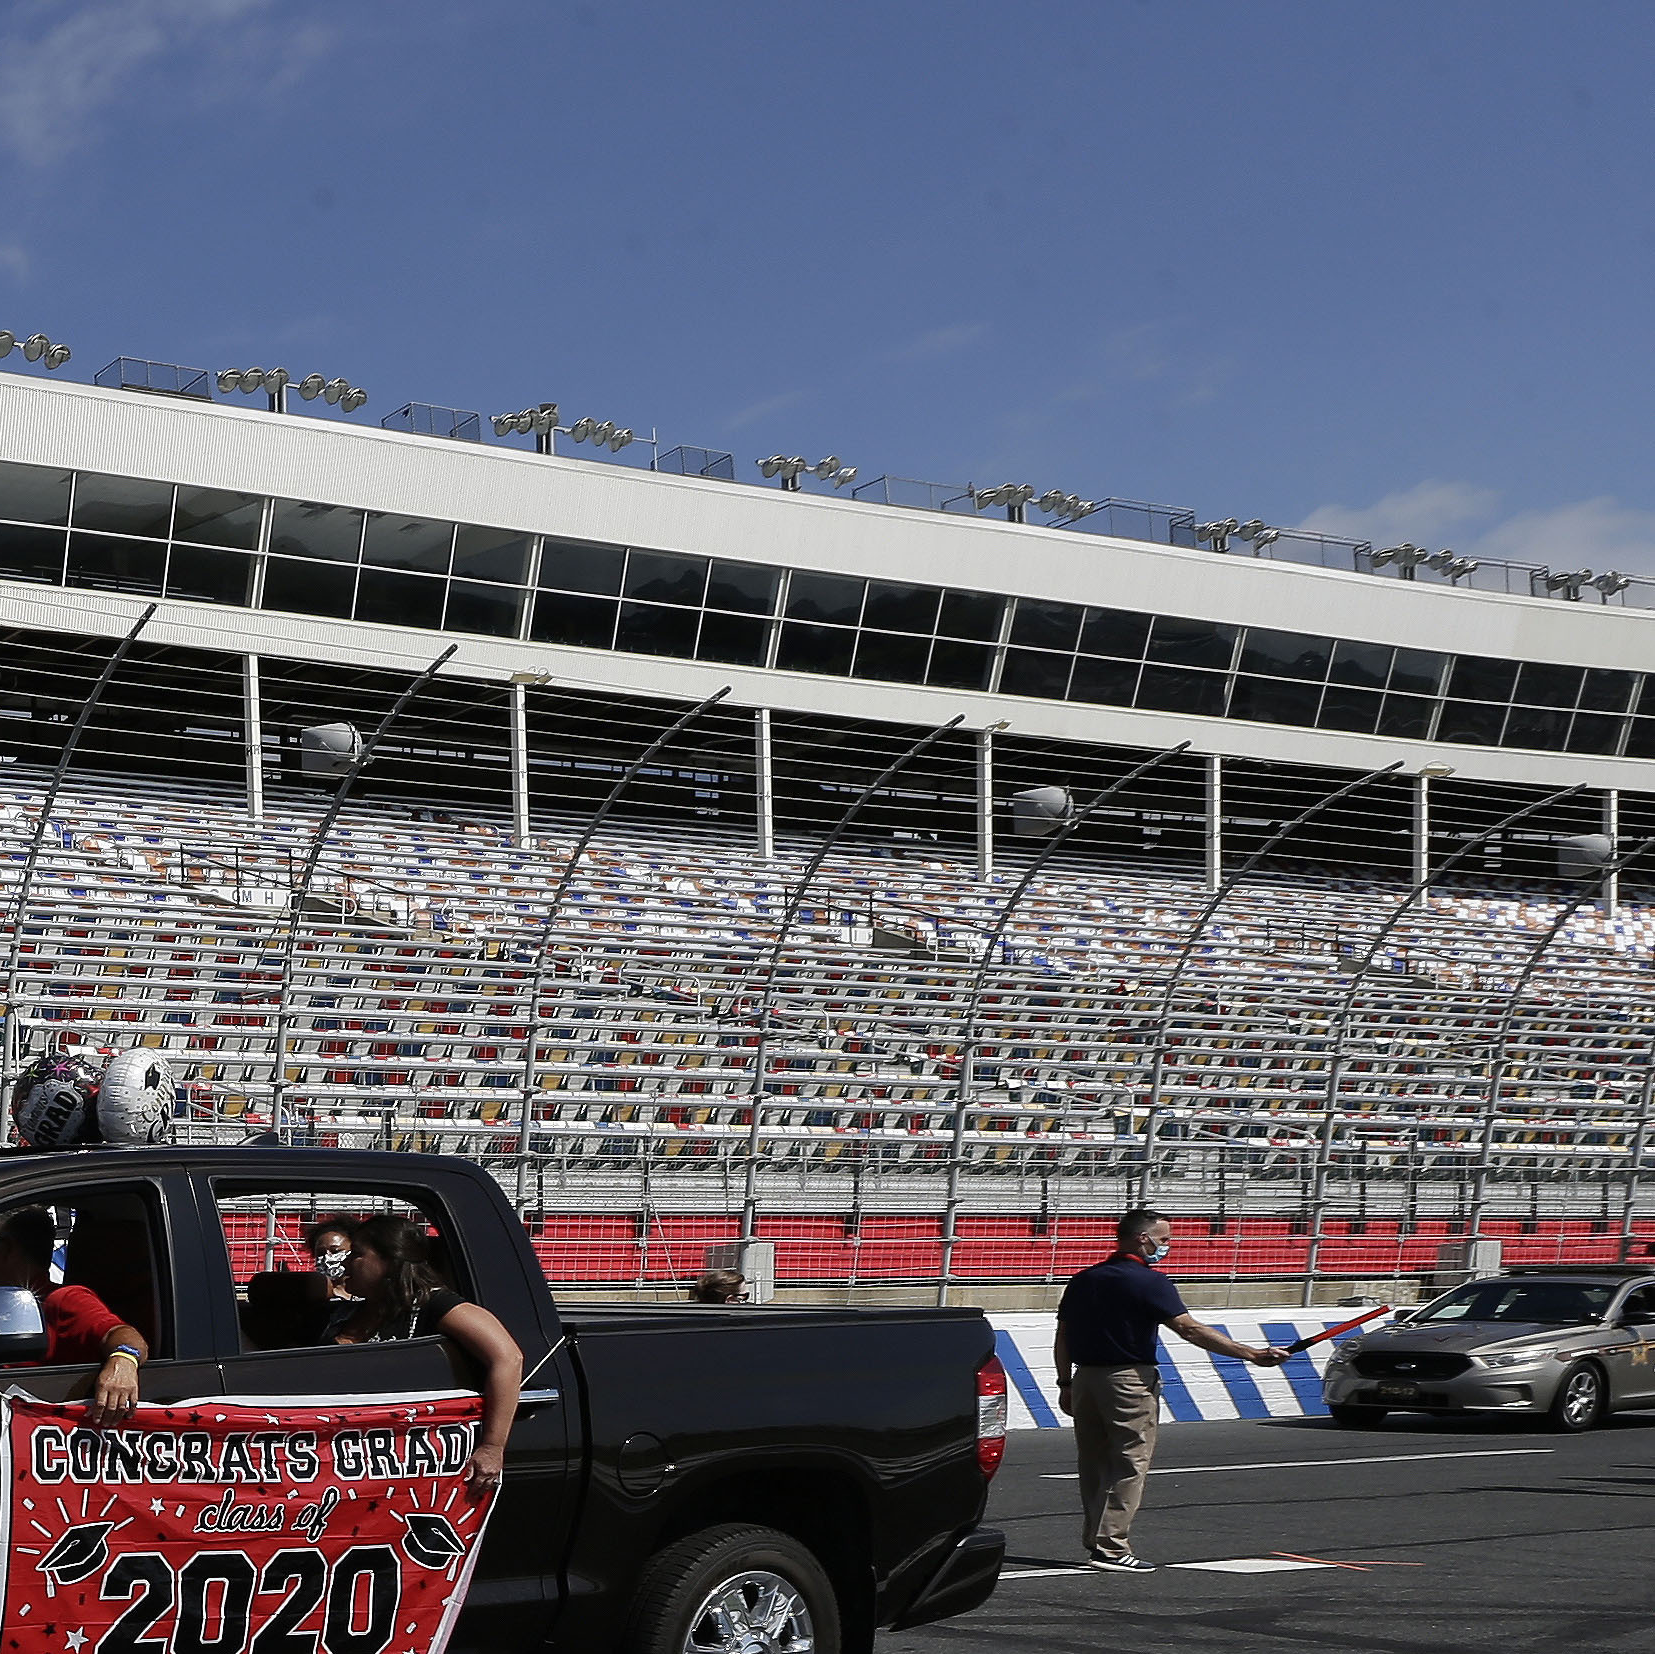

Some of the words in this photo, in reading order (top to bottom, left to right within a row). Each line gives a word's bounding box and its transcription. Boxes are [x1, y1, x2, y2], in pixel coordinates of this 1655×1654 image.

[30, 1424, 320, 1486] CONGRATS
[192, 1487, 286, 1534] class
[291, 1486, 343, 1543] of
